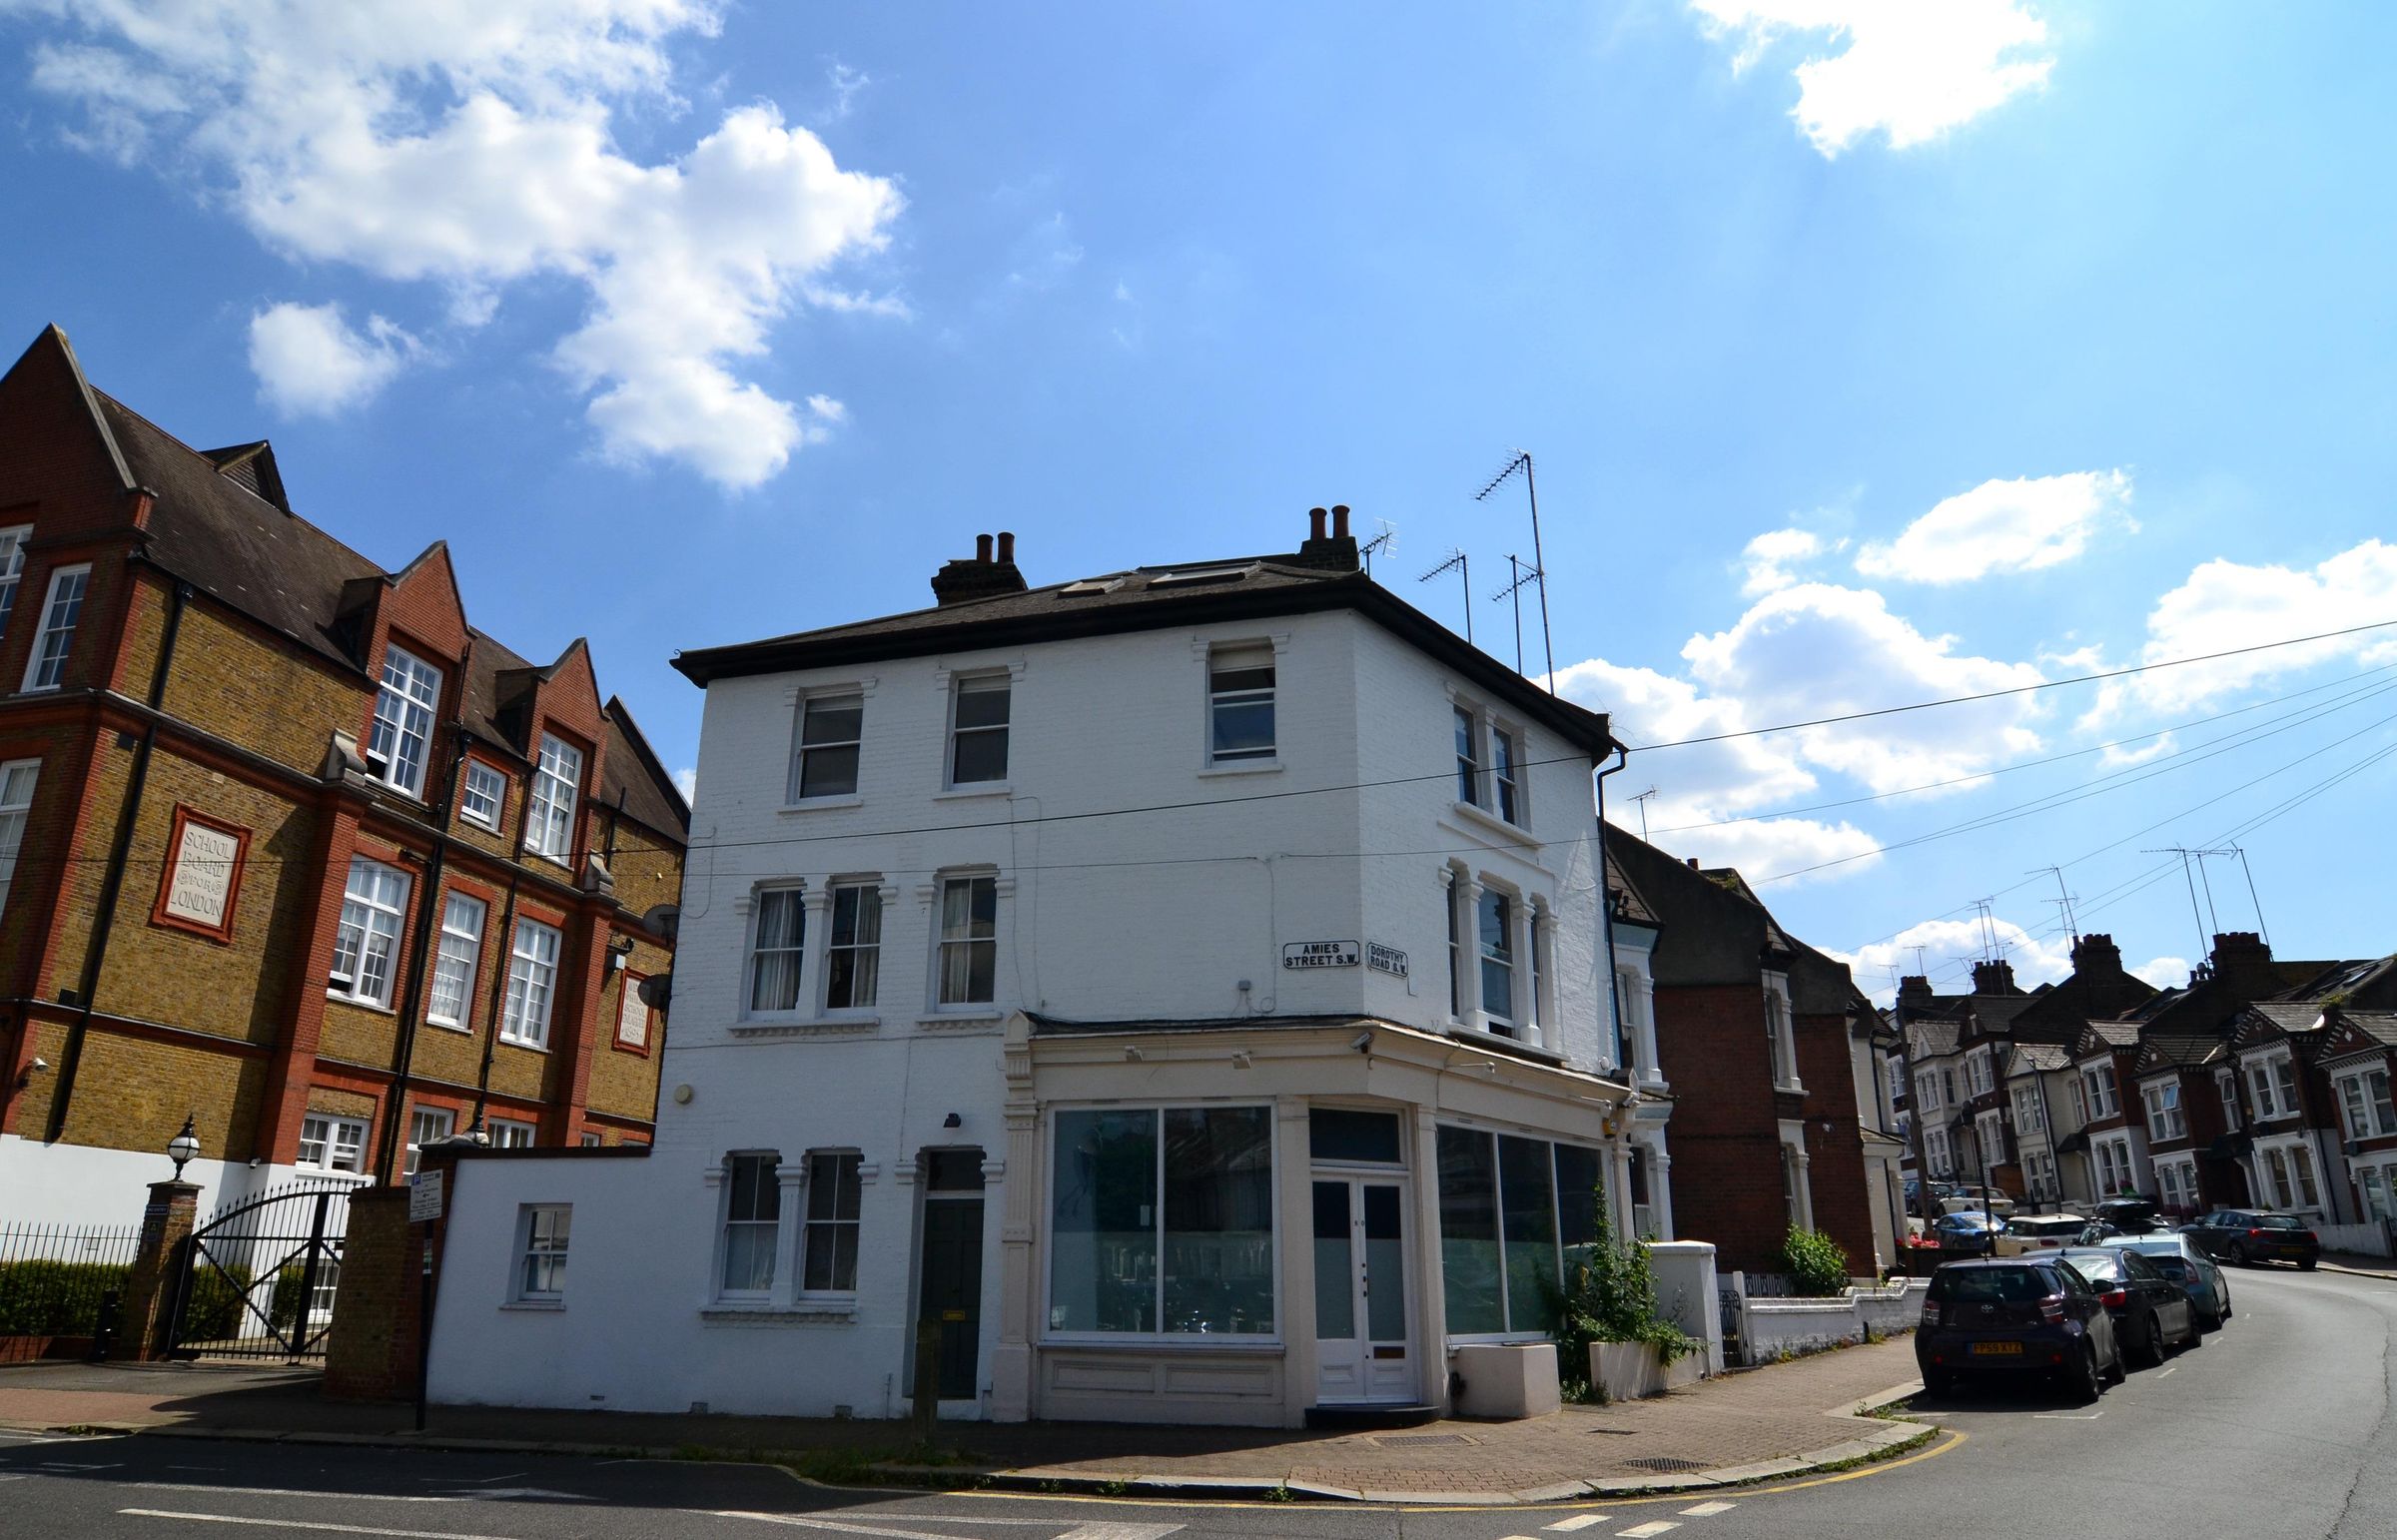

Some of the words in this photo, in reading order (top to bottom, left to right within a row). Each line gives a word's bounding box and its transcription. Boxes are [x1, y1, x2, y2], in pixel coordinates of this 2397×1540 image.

[184, 831, 231, 860] SCHOOL
[182, 851, 225, 877] BOARD
[190, 874, 212, 893] FOR
[170, 888, 223, 918] LONDON
[1302, 943, 1340, 955] AMIES
[1370, 945, 1404, 964] DOROTHY
[1285, 955, 1333, 967] STREET
[1370, 956, 1390, 971] ROAD
